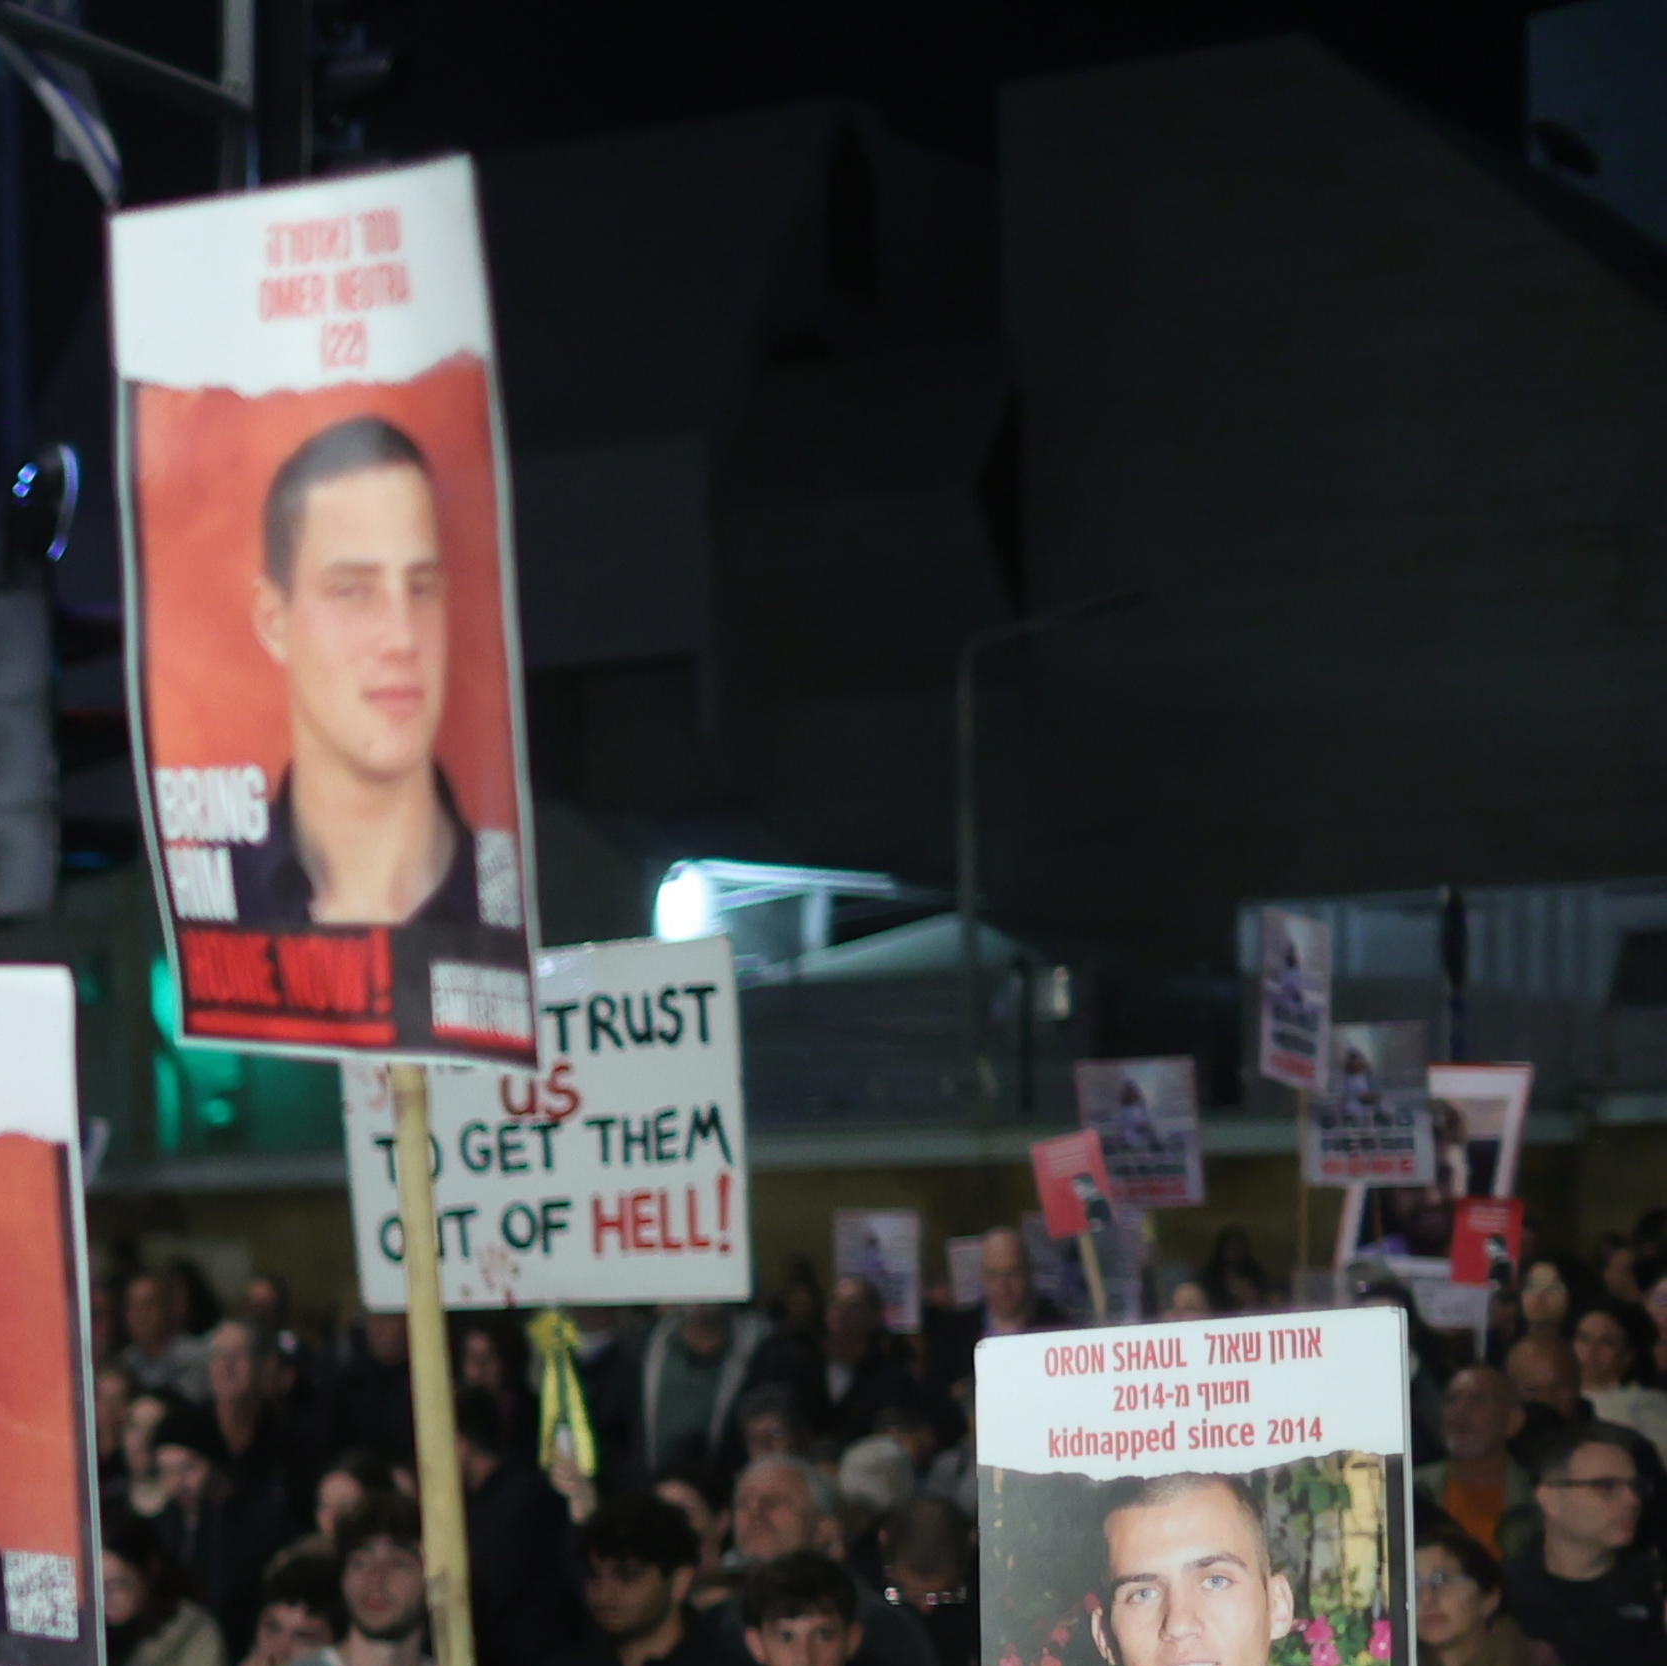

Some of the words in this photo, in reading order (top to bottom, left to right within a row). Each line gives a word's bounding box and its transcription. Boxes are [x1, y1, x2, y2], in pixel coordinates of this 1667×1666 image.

[154, 764, 270, 844] BRING
[543, 982, 716, 1053] TRUST
[459, 1121, 566, 1174] GET
[585, 1102, 734, 1166] THEM
[377, 1206, 478, 1263] OT
[500, 1200, 572, 1254] OF
[589, 1174, 734, 1254] HELL!
[1043, 1339, 1104, 1377] ORON
[1111, 1334, 1187, 1372] SHAUL
[1205, 1332, 1262, 1365] שאול
[1268, 1327, 1323, 1365] אורון
[1195, 1379, 1251, 1410] חטוף
[1048, 1424, 1179, 1463] kidnapped
[1187, 1419, 1255, 1450] since
[1266, 1418, 1323, 1445] 2014
